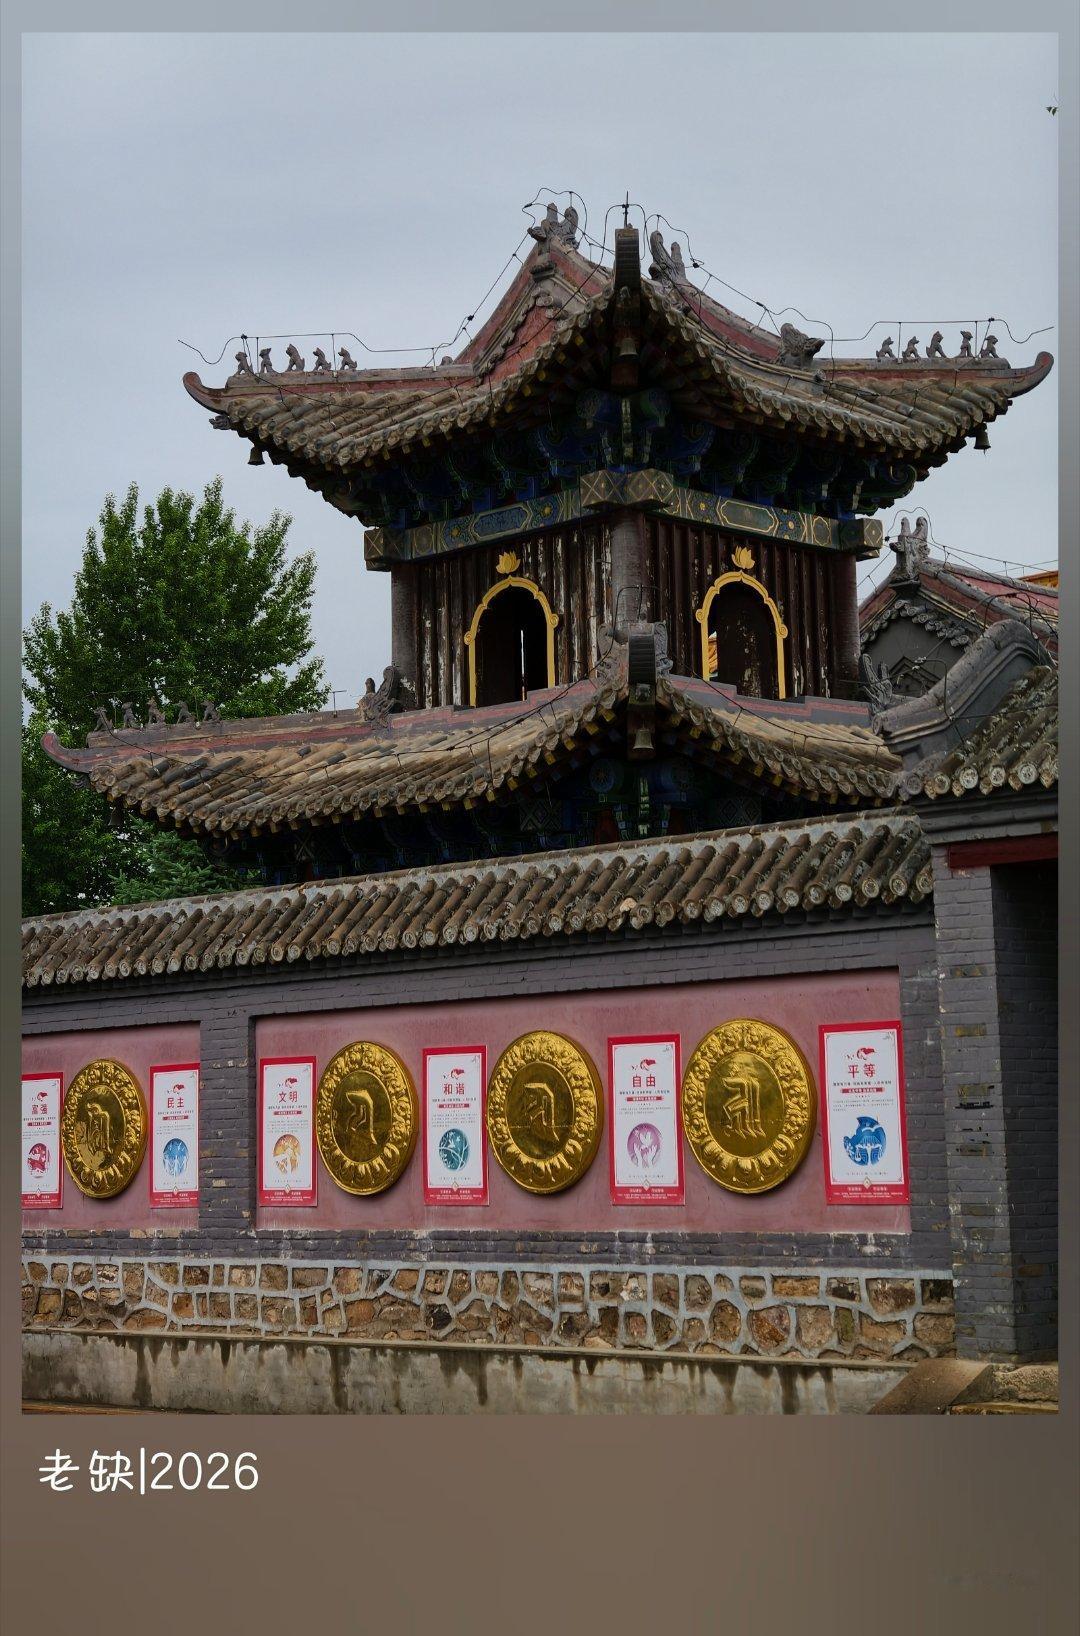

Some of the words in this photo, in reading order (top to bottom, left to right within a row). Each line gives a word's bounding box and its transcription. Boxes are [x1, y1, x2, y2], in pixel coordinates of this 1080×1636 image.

[847, 1063, 876, 1078] 平等
[632, 1073, 656, 1087] 自由
[443, 1083, 466, 1095] 和谐
[167, 1097, 185, 1109] 民主
[278, 1091, 298, 1103] 文明
